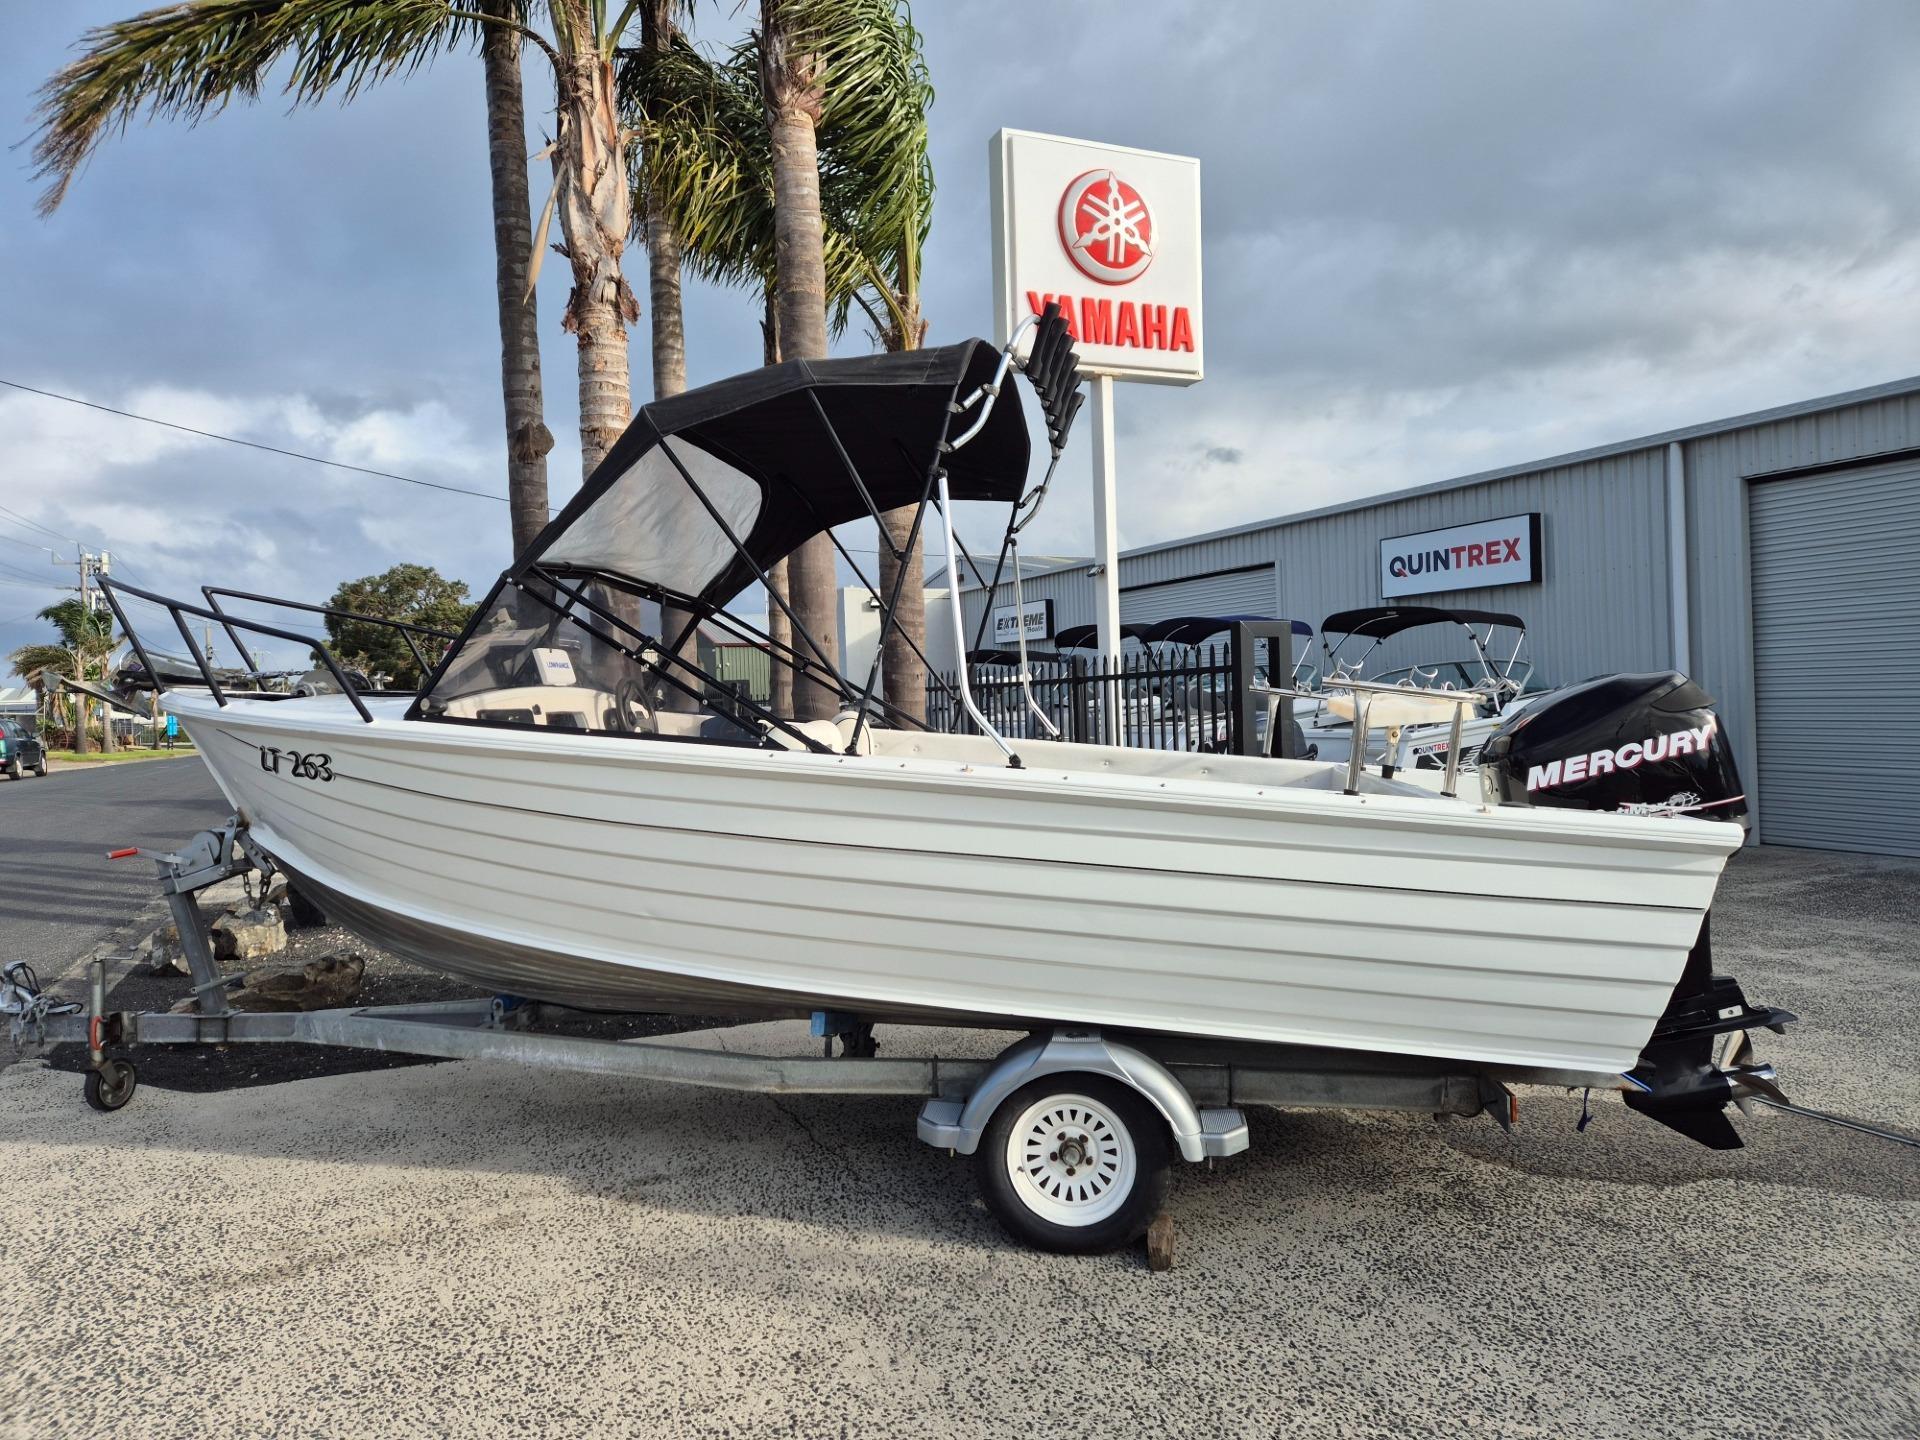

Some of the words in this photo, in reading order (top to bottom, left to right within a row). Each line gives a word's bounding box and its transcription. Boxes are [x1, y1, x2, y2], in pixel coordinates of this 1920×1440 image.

[1389, 537, 1521, 577] QUINTREX
[287, 750, 336, 782] 263
[1526, 724, 1714, 792] MERCURY
